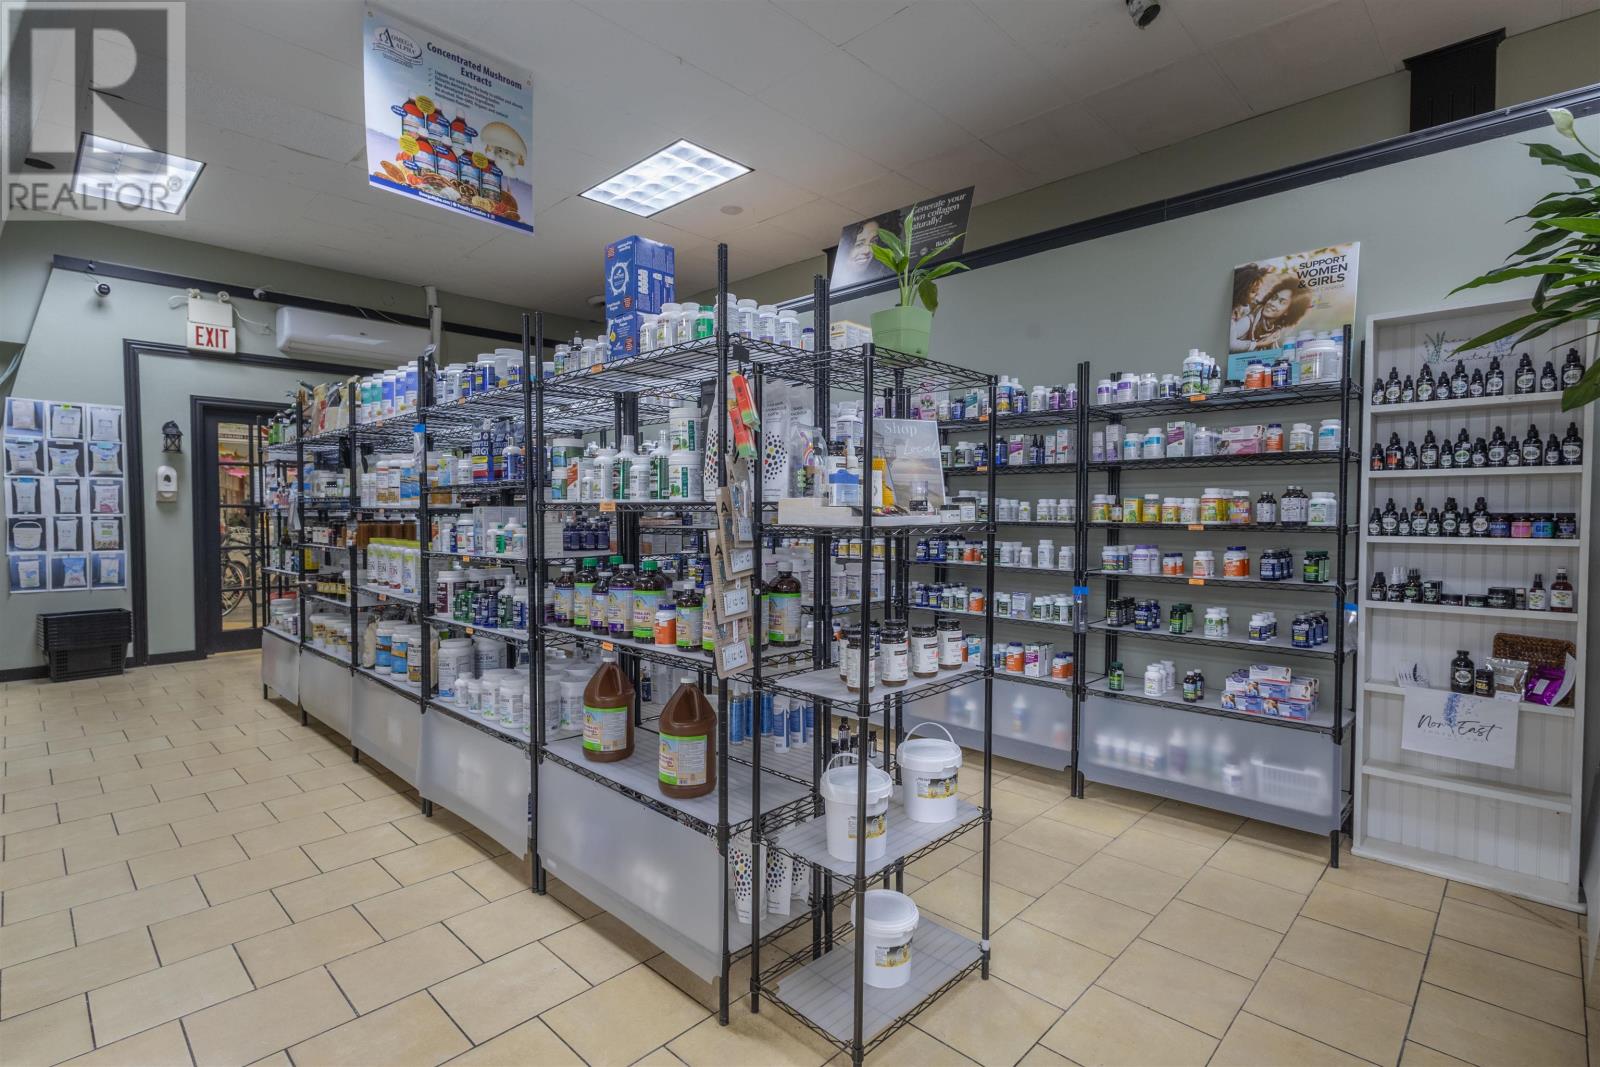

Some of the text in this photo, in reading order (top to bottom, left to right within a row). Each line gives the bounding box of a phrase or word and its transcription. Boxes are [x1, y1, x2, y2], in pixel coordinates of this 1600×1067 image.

[427, 42, 482, 72] Concentrated
[483, 66, 522, 90] Mushroom
[461, 67, 492, 87] Extracts
[948, 193, 967, 206] your
[913, 204, 960, 222] wn collagen
[912, 215, 943, 229] aturally!
[1297, 263, 1348, 279] WOMEN
[1299, 255, 1347, 270] SUPPORT
[1298, 279, 1307, 289] &
[1308, 273, 1346, 287] GIRLS
[195, 325, 229, 349] EXIT
[1457, 720, 1503, 741] East
